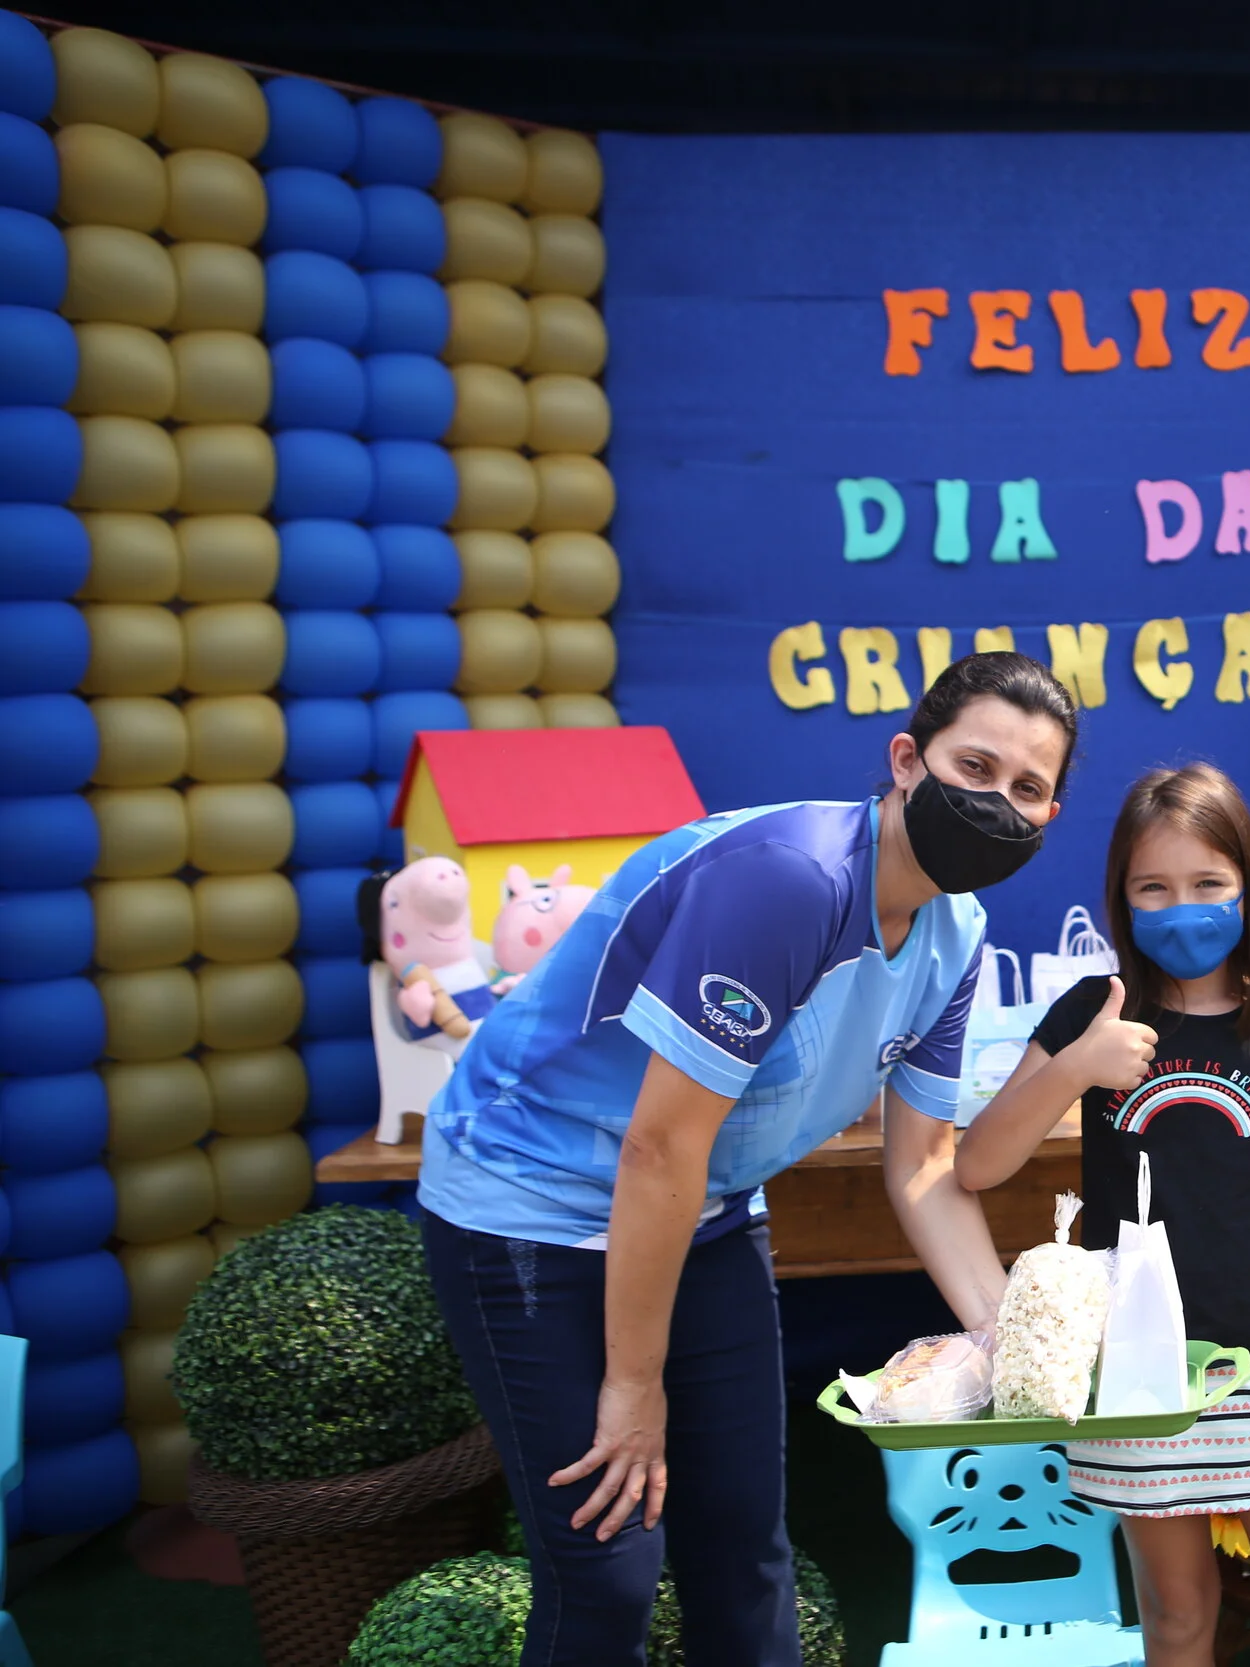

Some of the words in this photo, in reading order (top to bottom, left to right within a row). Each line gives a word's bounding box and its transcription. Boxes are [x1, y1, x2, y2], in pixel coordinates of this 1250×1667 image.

[836, 477, 1058, 564] DIA
[1141, 1058, 1193, 1084] UTURE
[1205, 1060, 1221, 1075] IS
